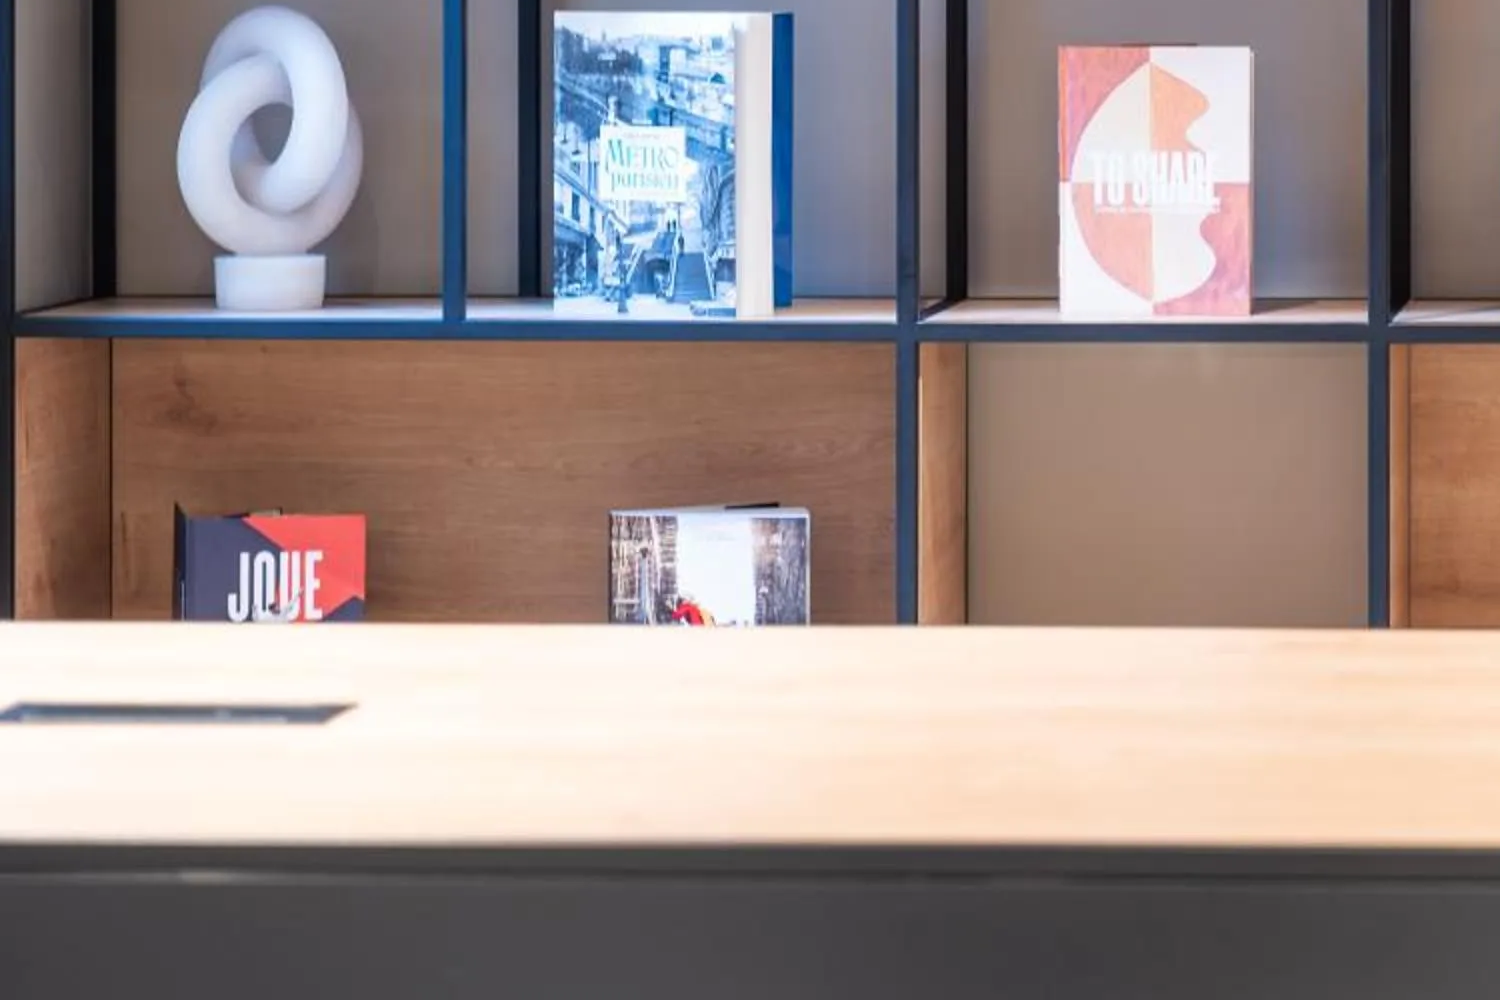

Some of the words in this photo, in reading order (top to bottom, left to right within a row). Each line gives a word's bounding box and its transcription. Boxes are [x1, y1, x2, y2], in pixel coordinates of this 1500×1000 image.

[1089, 150, 1125, 205] TO
[1130, 150, 1219, 206] SHARE
[227, 550, 323, 622] JOUE
